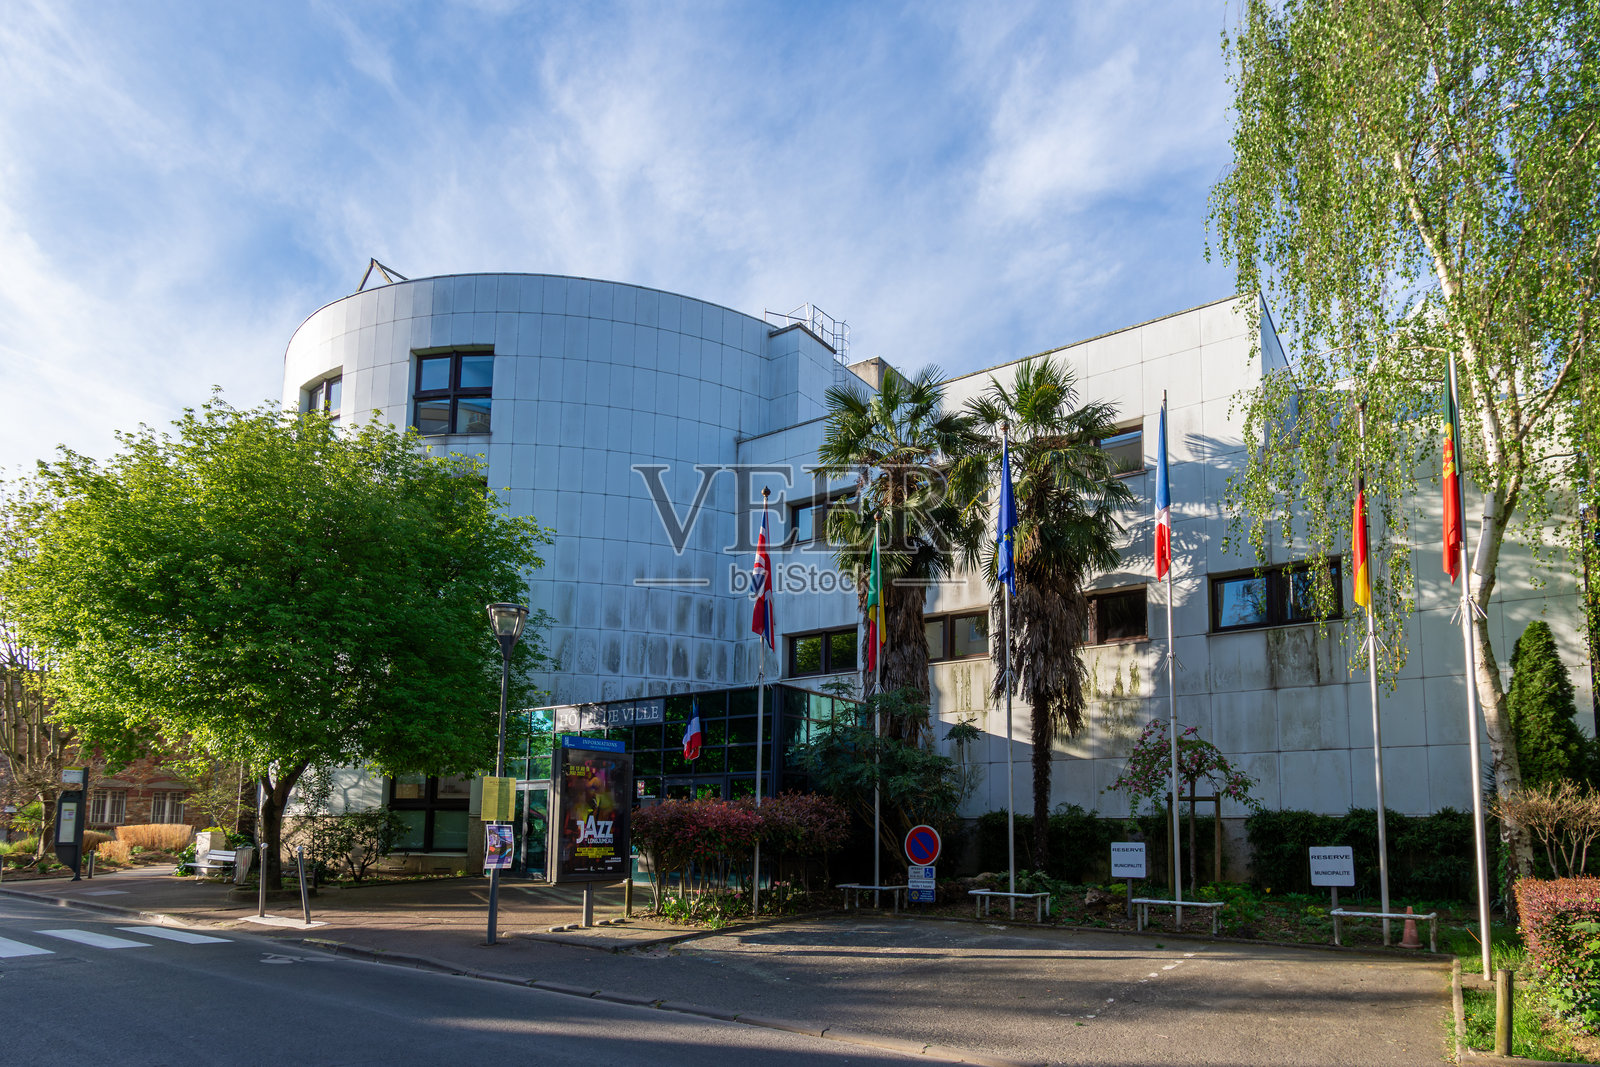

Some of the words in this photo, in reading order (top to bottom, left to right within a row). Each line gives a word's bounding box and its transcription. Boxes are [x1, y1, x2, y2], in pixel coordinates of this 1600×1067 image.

[602, 709, 619, 723] DE
[622, 706, 659, 720] VILLE
[582, 739, 618, 748] INFORMATIONS
